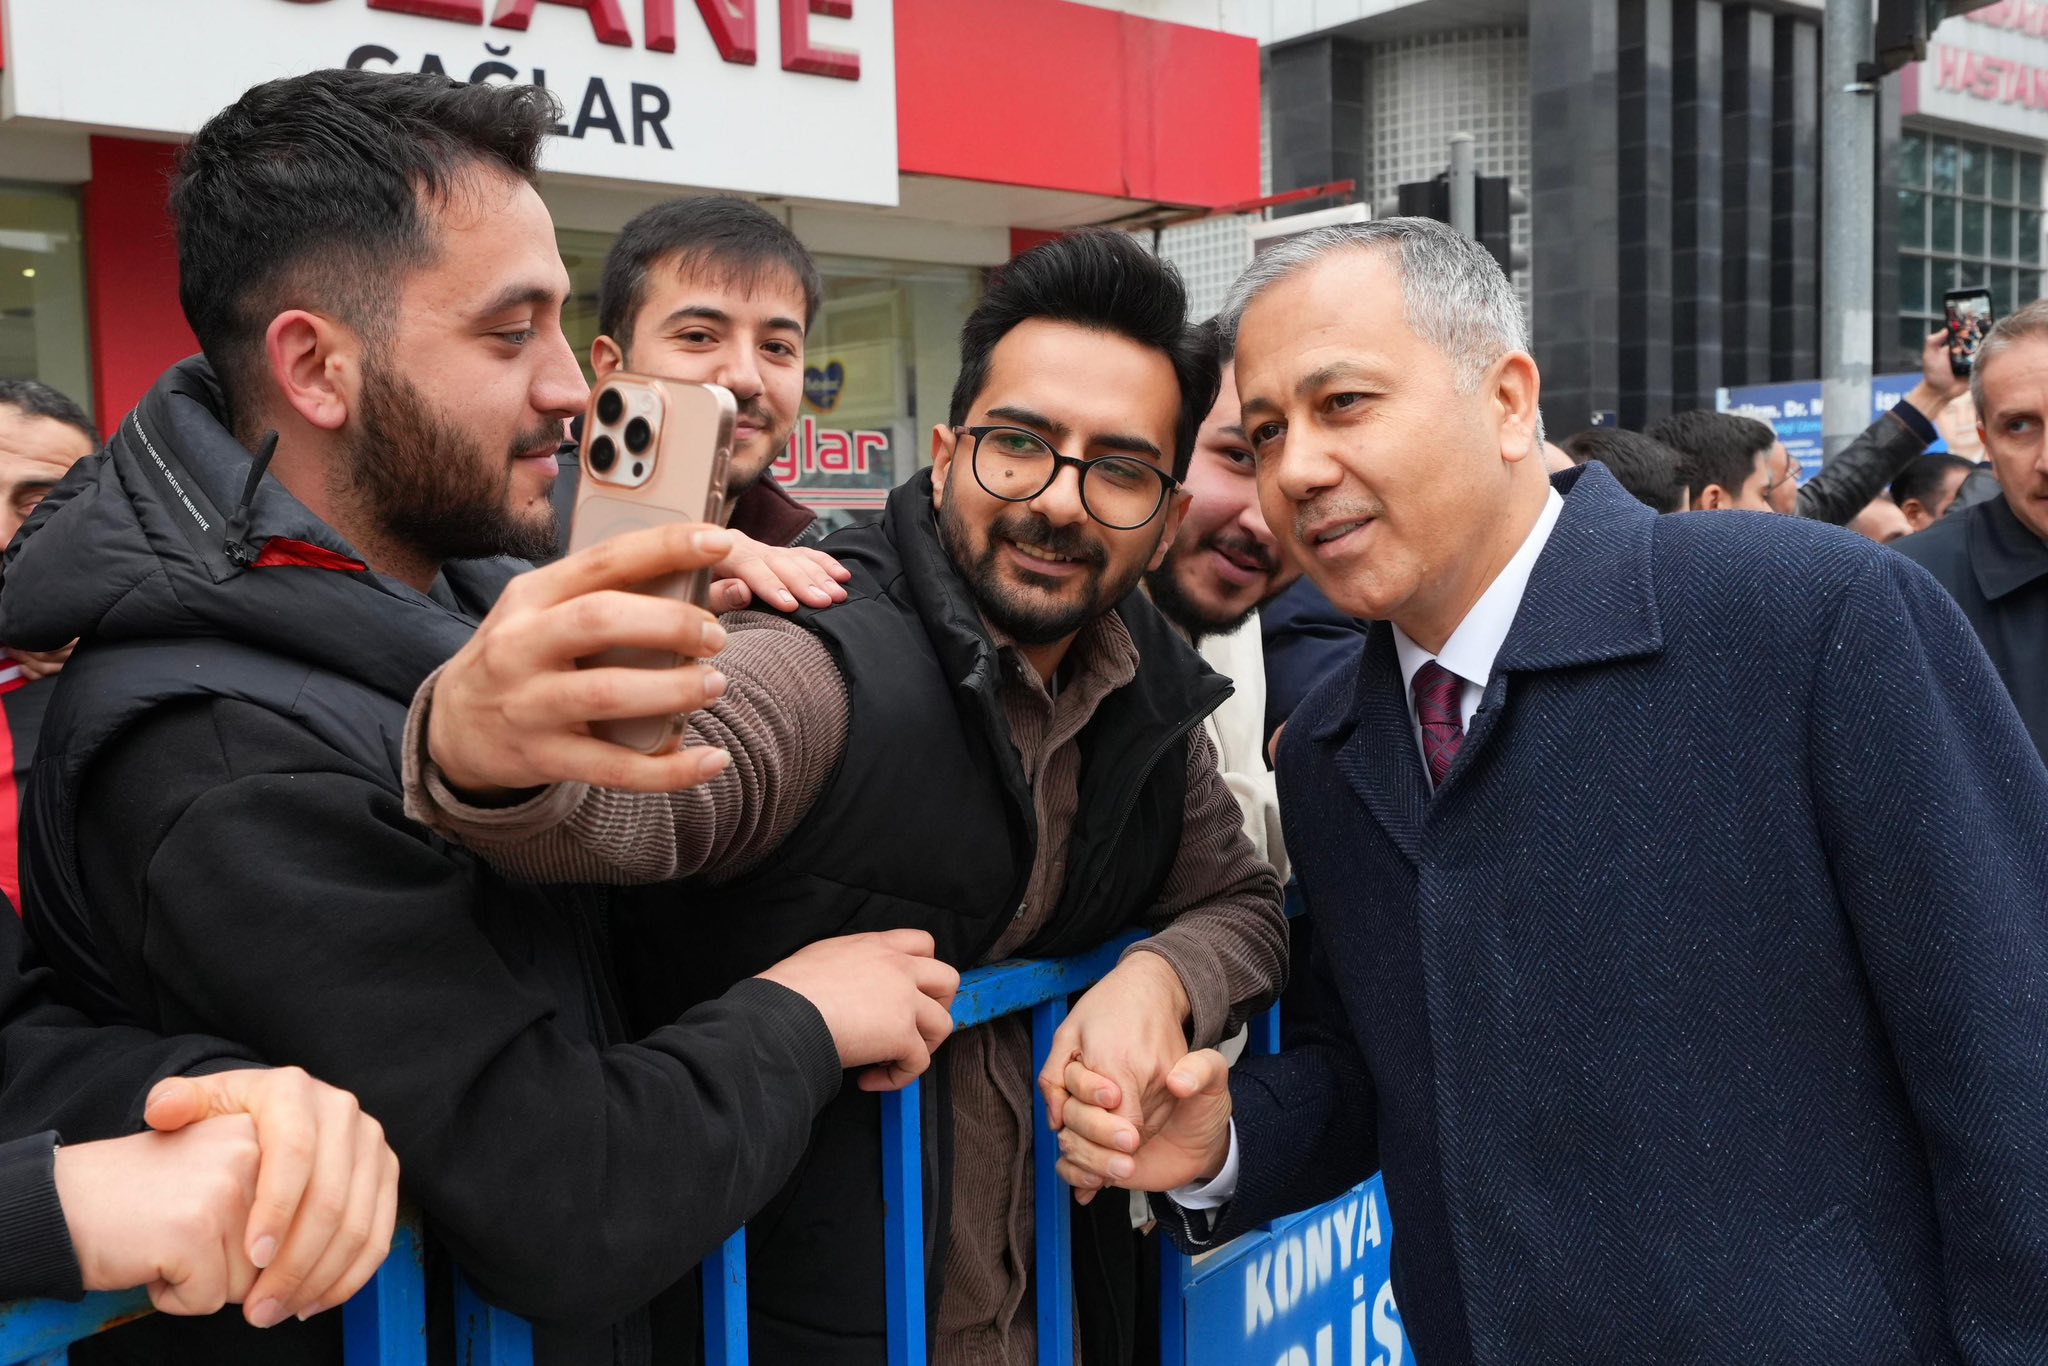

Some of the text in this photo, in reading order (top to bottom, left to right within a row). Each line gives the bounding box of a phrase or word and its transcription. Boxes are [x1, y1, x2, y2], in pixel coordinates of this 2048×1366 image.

[147, 443, 167, 471] COMFORT
[164, 469, 184, 497] CREATIVE
[182, 495, 210, 531] INNOVATIVE
[1246, 1192, 1382, 1338] KONYA
